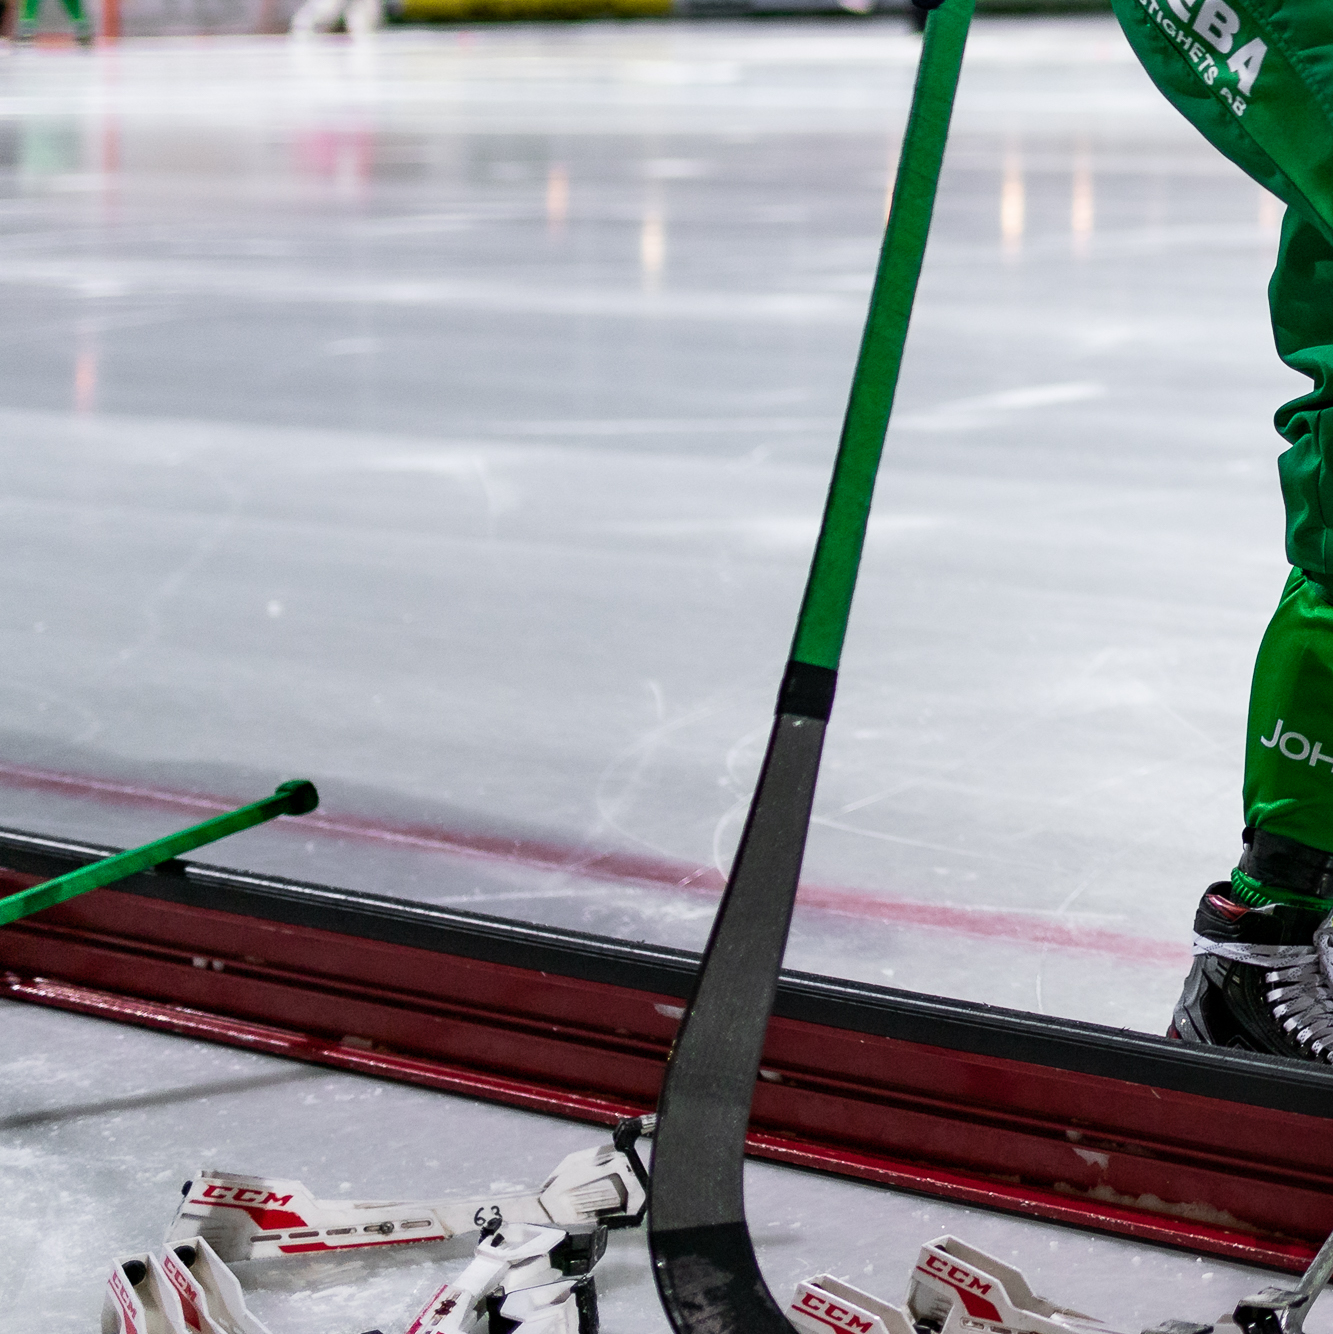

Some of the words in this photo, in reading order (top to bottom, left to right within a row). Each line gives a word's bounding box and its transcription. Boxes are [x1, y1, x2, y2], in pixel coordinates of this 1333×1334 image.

[202, 1183, 295, 1207] CCM
[112, 1270, 138, 1319] CCM
[162, 1254, 199, 1303] CCM
[925, 1254, 994, 1296] CCM
[800, 1291, 876, 1334] CCM
